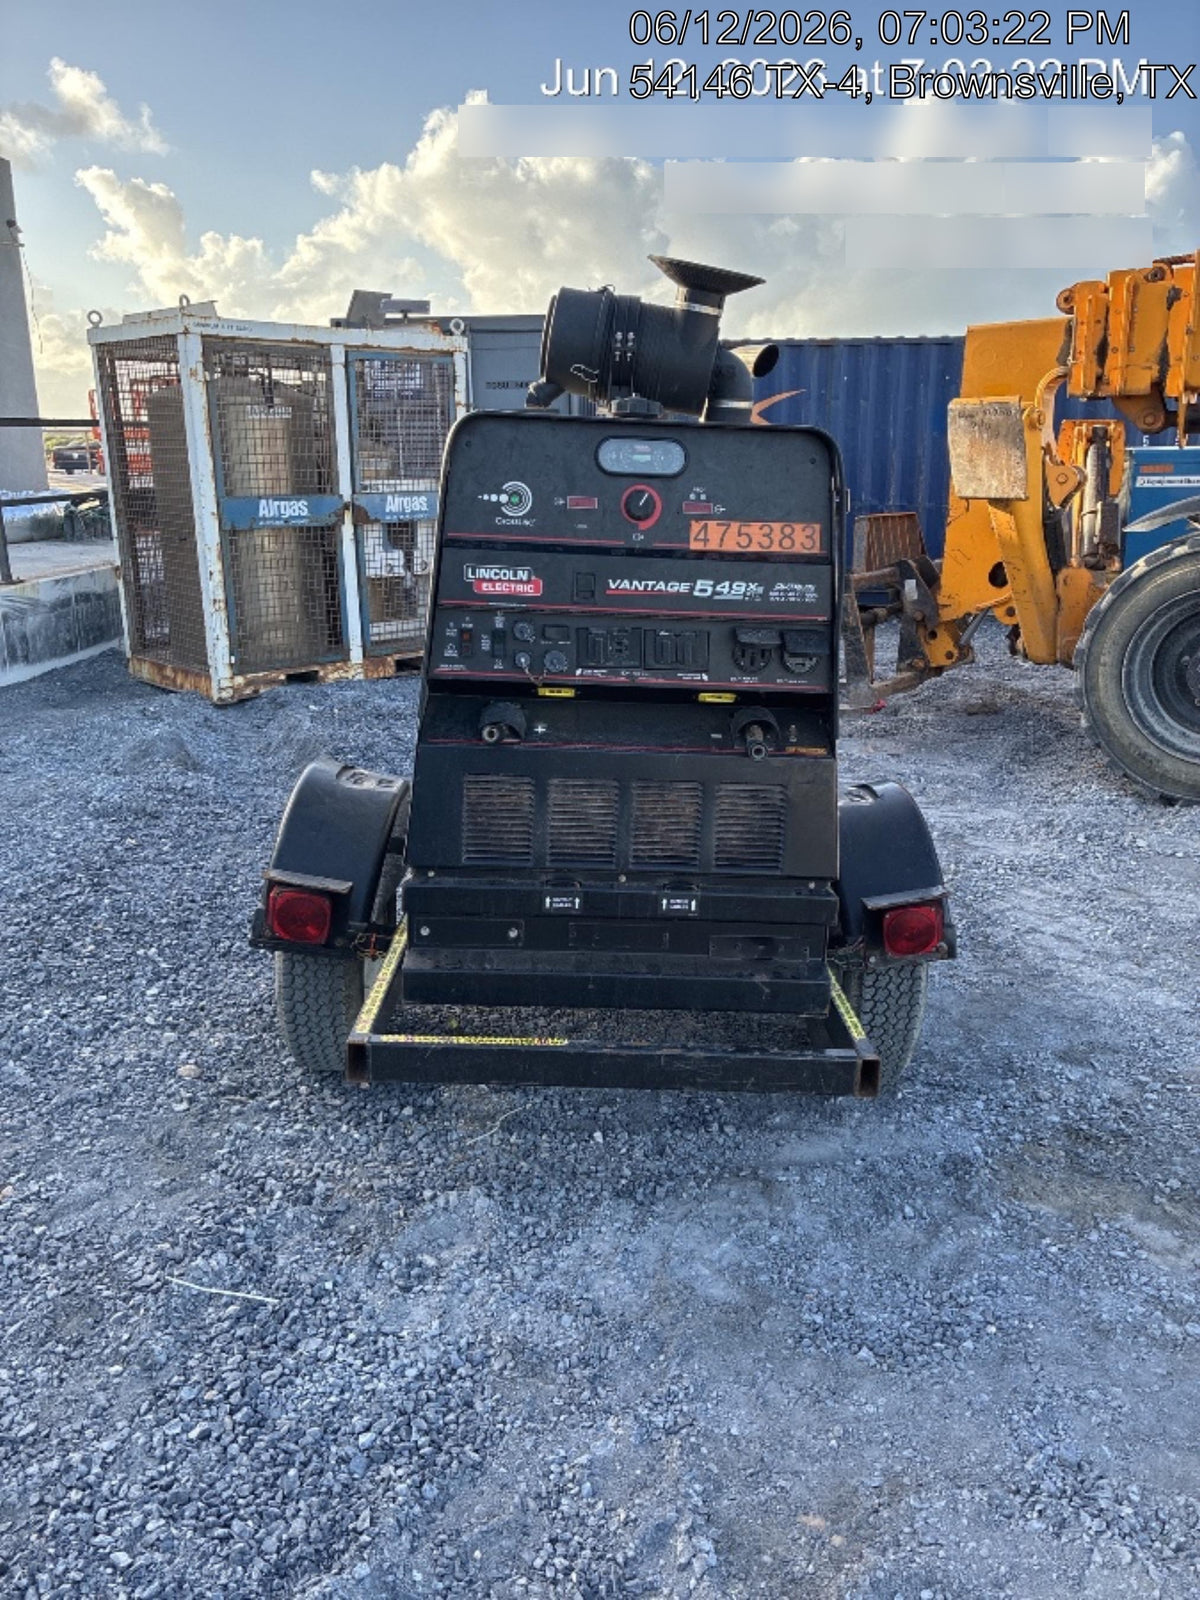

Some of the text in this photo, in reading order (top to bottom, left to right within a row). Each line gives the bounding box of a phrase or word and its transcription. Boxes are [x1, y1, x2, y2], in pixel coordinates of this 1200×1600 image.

[258, 499, 310, 518] Airgas
[385, 494, 429, 513] Airgas
[693, 523, 816, 550] 475383
[467, 567, 529, 581] LINCOLN
[481, 582, 535, 593] ELECTRIC
[608, 579, 691, 593] VANTAGE
